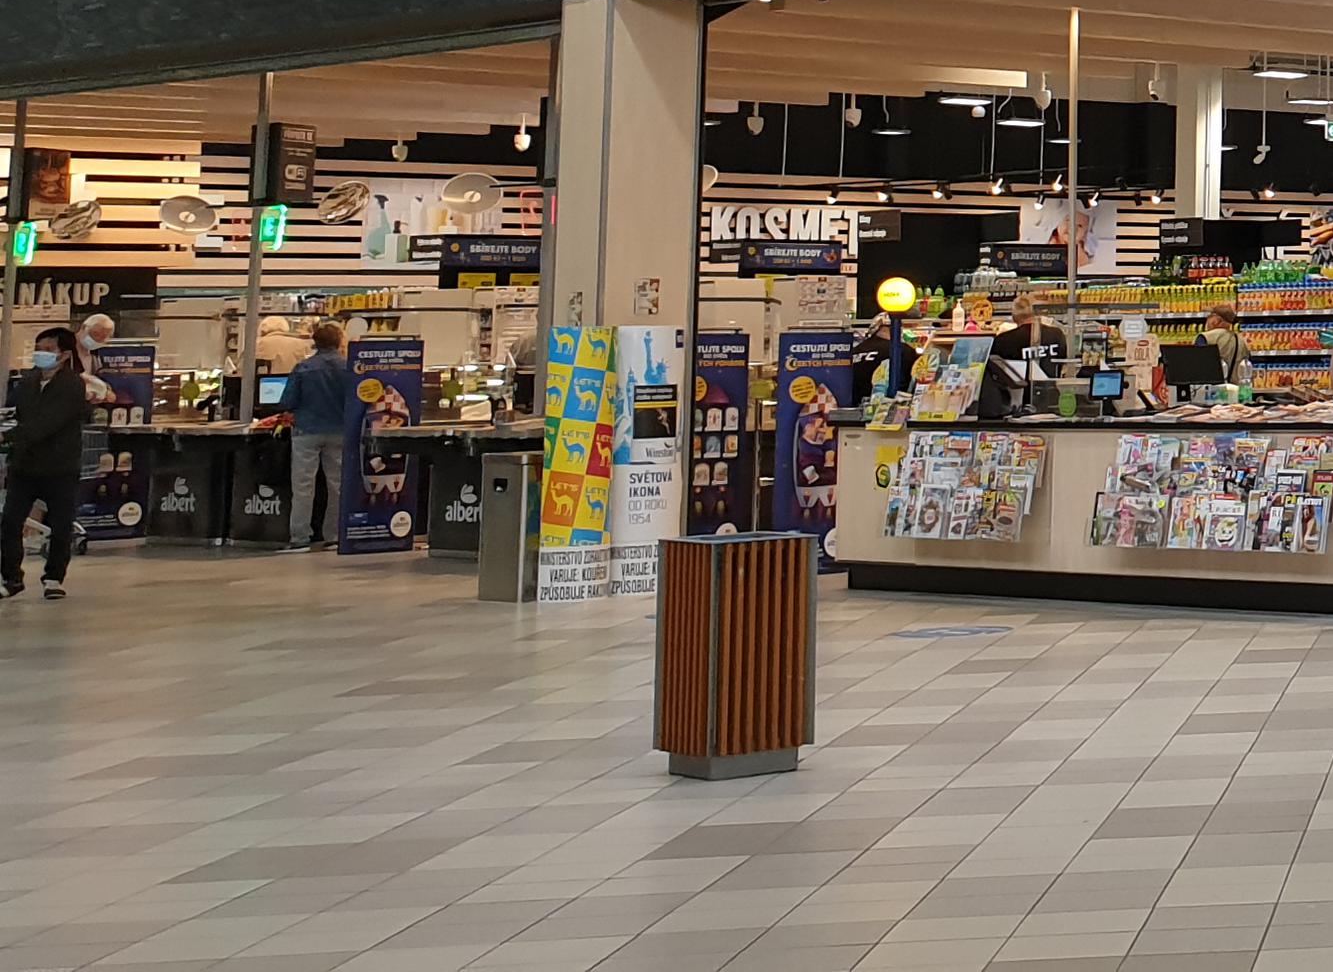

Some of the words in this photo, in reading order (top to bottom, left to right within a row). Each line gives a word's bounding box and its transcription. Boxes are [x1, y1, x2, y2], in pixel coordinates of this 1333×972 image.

[711, 206, 858, 259] KOSMET
[510, 246, 538, 254] BODY
[18, 277, 110, 305] NÁKUP
[629, 469, 673, 484] SVĚTOVÁ
[629, 486, 661, 498] IKONA
[160, 492, 196, 512] albert
[244, 495, 281, 516] albert
[628, 500, 642, 511] OD
[644, 499, 667, 510] ROKU
[628, 513, 651, 524] 1954
